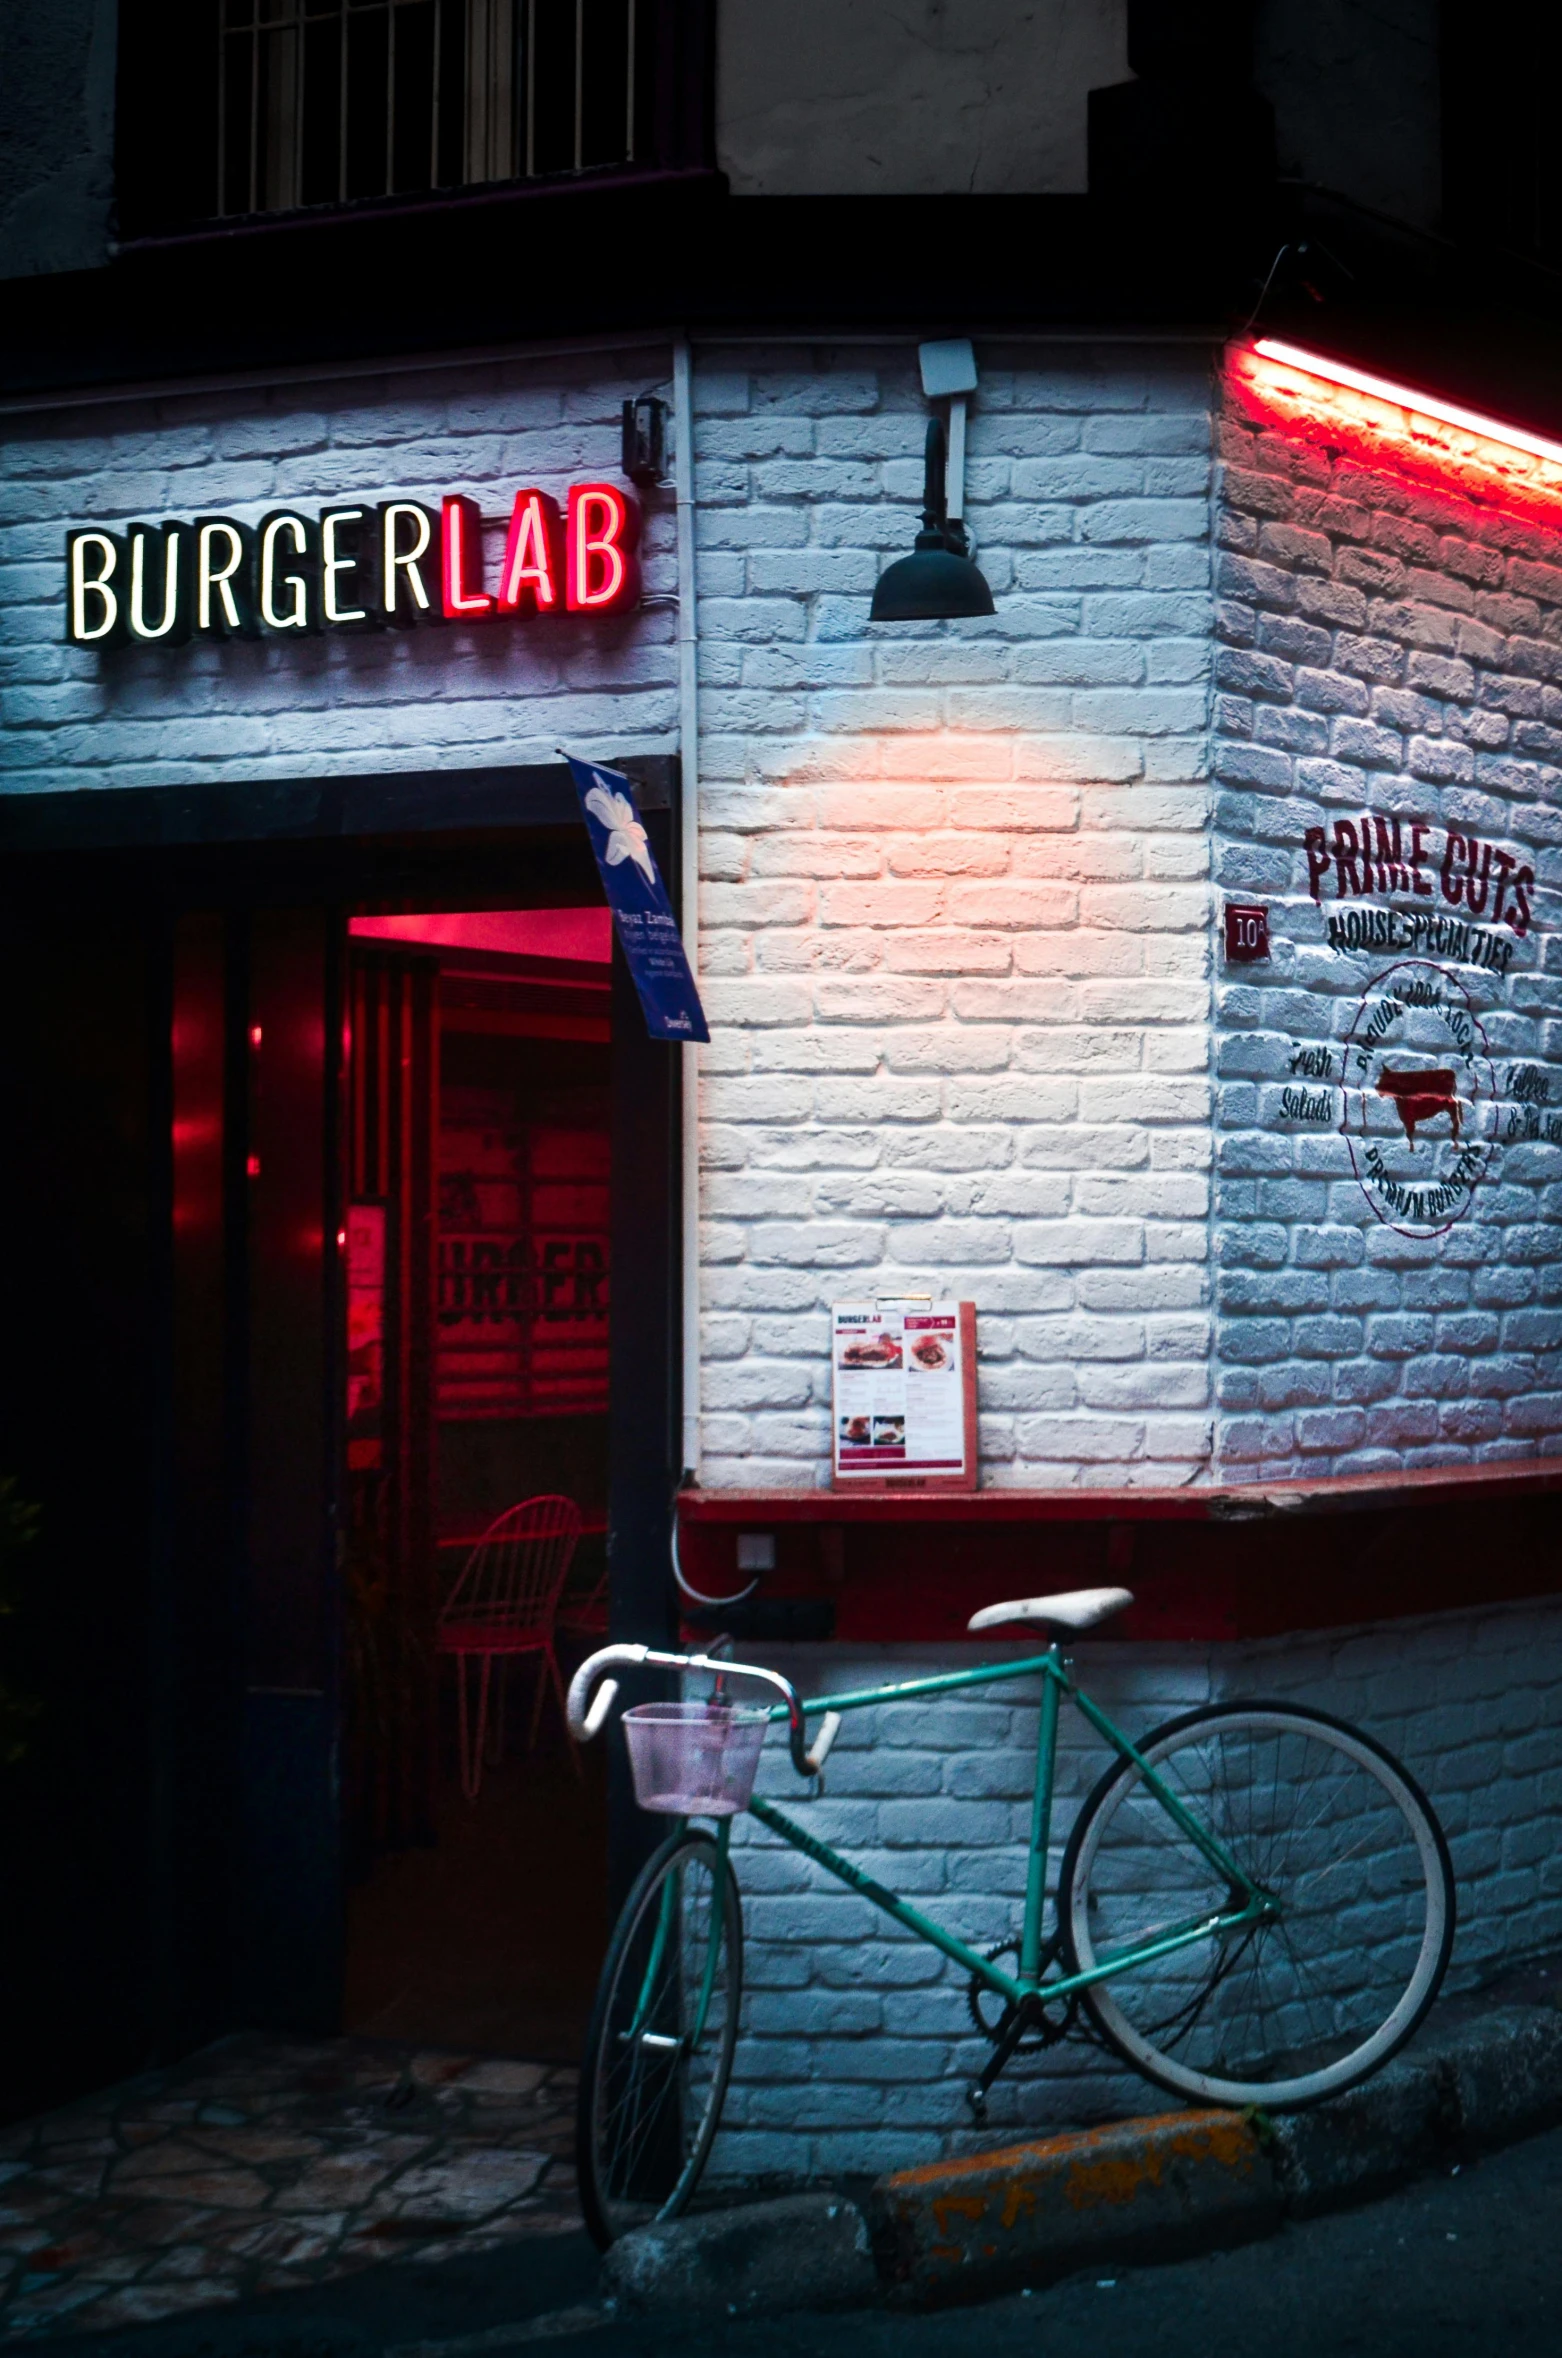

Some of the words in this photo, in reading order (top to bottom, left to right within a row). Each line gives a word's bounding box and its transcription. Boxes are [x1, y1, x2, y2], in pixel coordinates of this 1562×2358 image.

[1304, 816, 1433, 907] PRIME
[1439, 828, 1535, 937] CUTS
[1328, 910, 1400, 955] HOUSE
[1396, 910, 1513, 978] SPECIALTIES
[1279, 1086, 1332, 1123] Salads
[1365, 1146, 1424, 1218] PREMIUM
